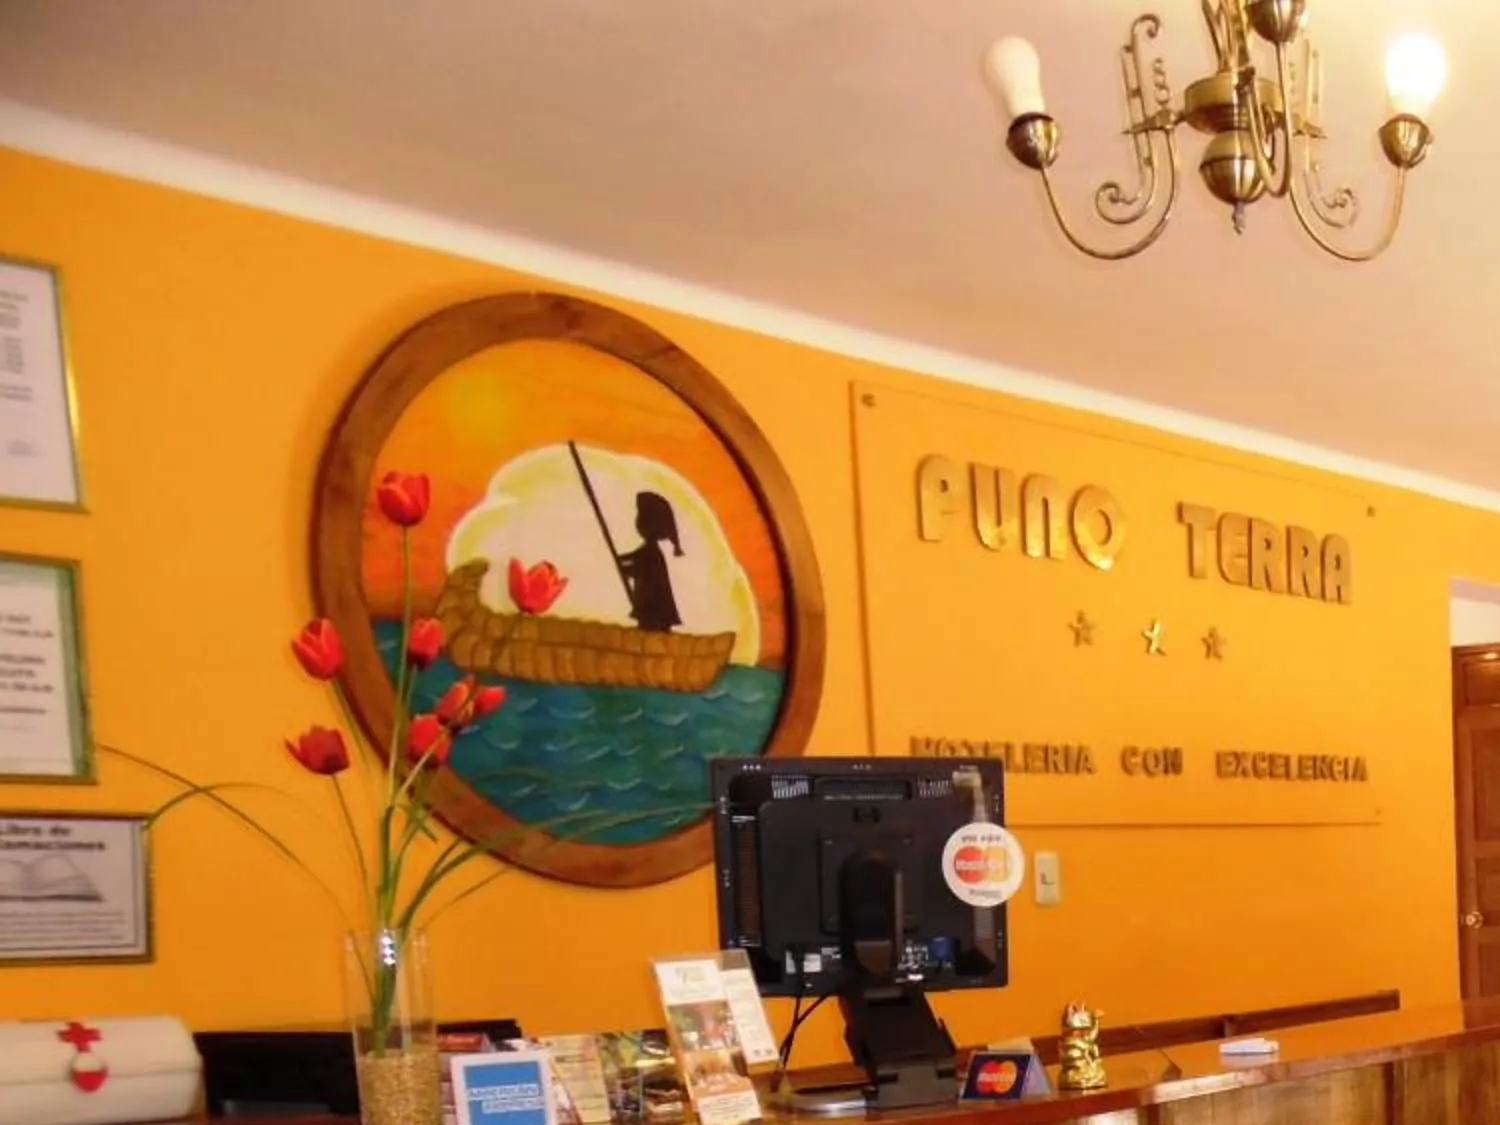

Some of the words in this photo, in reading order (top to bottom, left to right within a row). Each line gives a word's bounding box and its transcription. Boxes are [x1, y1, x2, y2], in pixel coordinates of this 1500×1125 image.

[915, 453, 1126, 572] PUNO
[1176, 501, 1352, 605] TERRA
[1119, 745, 1184, 777] CON
[1214, 750, 1369, 783] EXCELENCIA
